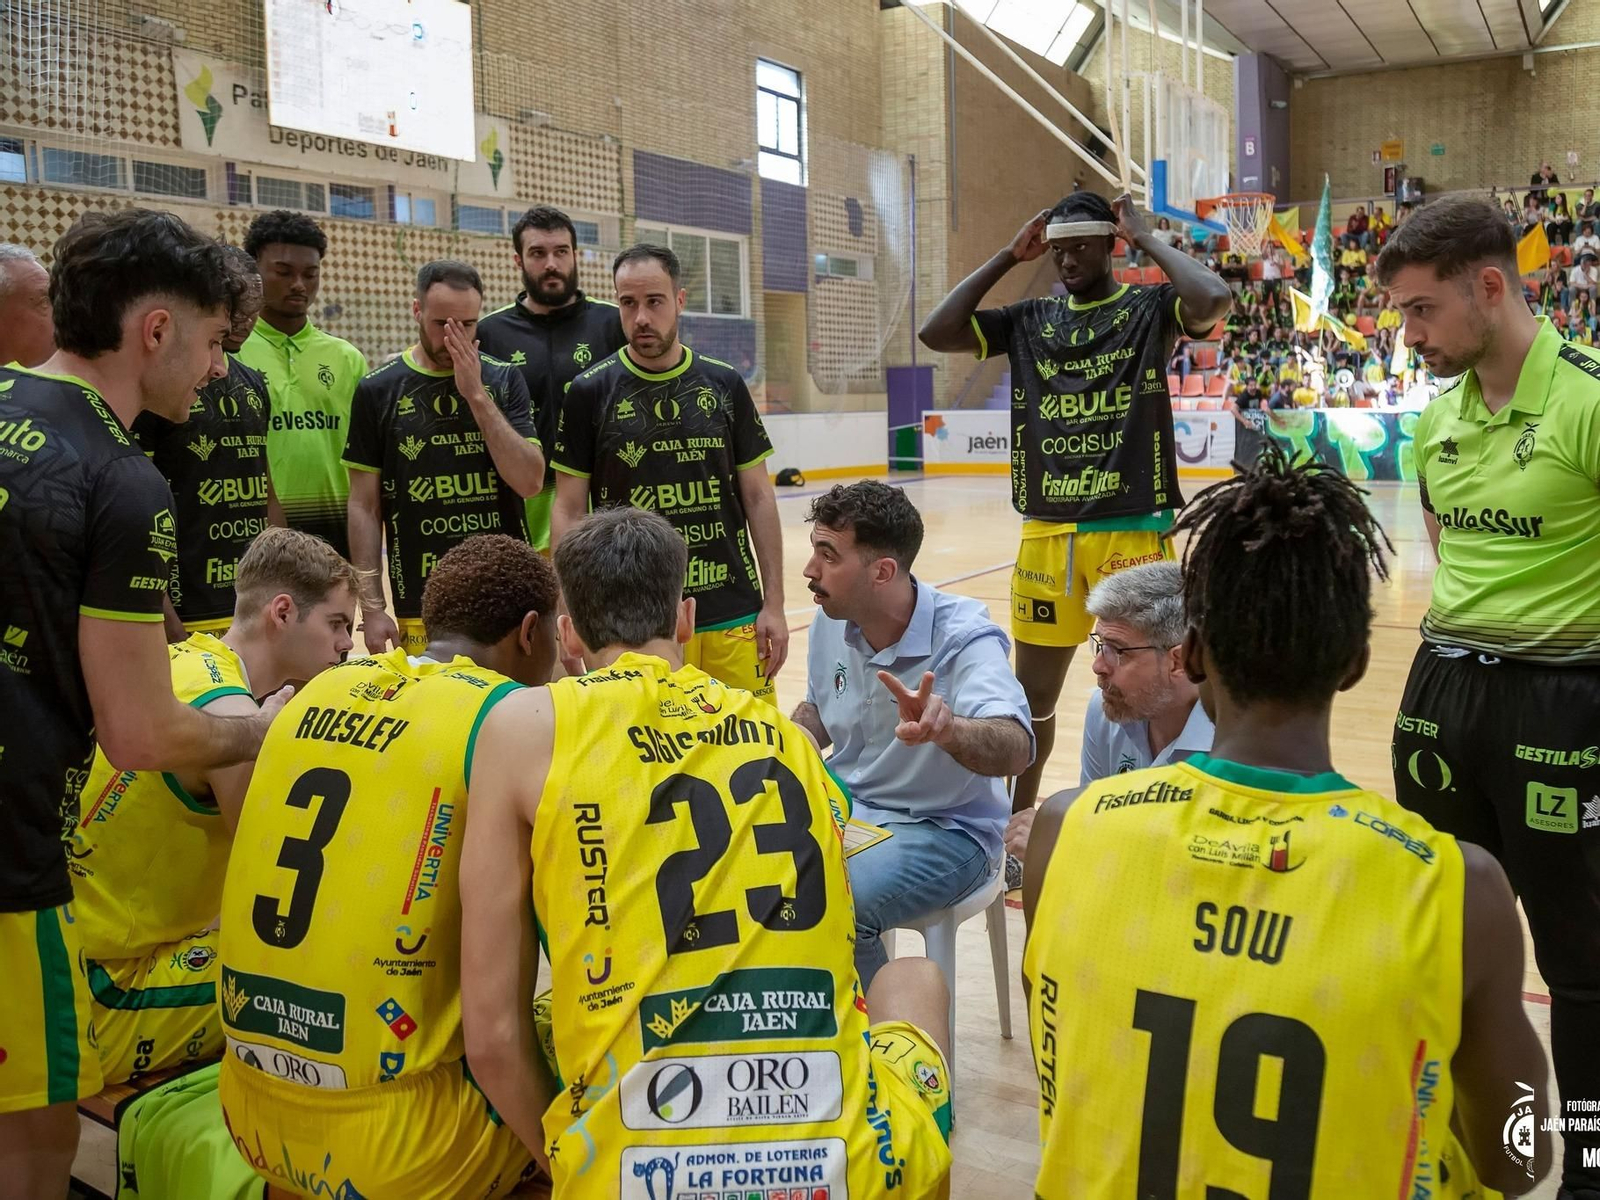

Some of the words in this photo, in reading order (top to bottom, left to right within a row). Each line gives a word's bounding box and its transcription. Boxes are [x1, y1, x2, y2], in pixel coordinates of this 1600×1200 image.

[1245, 141, 1255, 156] B
[1064, 361, 1093, 371] CAJA
[82, 389, 130, 446] RUSTER
[1079, 413, 1109, 424] GENUINO
[430, 434, 461, 446] CAJA
[454, 443, 484, 456] JAÉN
[652, 440, 683, 452] CAJA
[687, 437, 725, 449] RURAL
[1041, 430, 1124, 455] COCISUR
[676, 448, 706, 463] JAÉN
[679, 505, 707, 515] GENUINO
[420, 511, 501, 536] COCISUR
[1536, 792, 1567, 818] LZ
[1529, 817, 1575, 830] ASESORES
[252, 767, 352, 950] 3
[644, 756, 827, 959] 23
[1187, 844, 1206, 854] con
[1208, 846, 1229, 858] Luis
[573, 803, 609, 928] RUSTER
[1193, 901, 1293, 966] SOW
[373, 957, 437, 972] Ayuntamiento
[386, 967, 398, 976] de
[400, 967, 422, 977] Jaén
[253, 995, 287, 1017] CAJA
[288, 1002, 340, 1030] RURAL
[587, 1003, 600, 1012] de
[600, 995, 623, 1010] Jaén
[703, 992, 757, 1014] CAJA
[762, 990, 831, 1011] RURAL
[277, 1017, 309, 1042] JAEN
[741, 1010, 798, 1033] JAEN
[273, 1053, 321, 1087] ORO
[726, 1057, 810, 1092] ORO
[1132, 988, 1326, 1200] 19
[686, 1152, 740, 1167] ADMON.
[745, 1151, 764, 1163] DE
[688, 1171, 713, 1188] LA
[722, 1164, 823, 1187] FORTUNA
